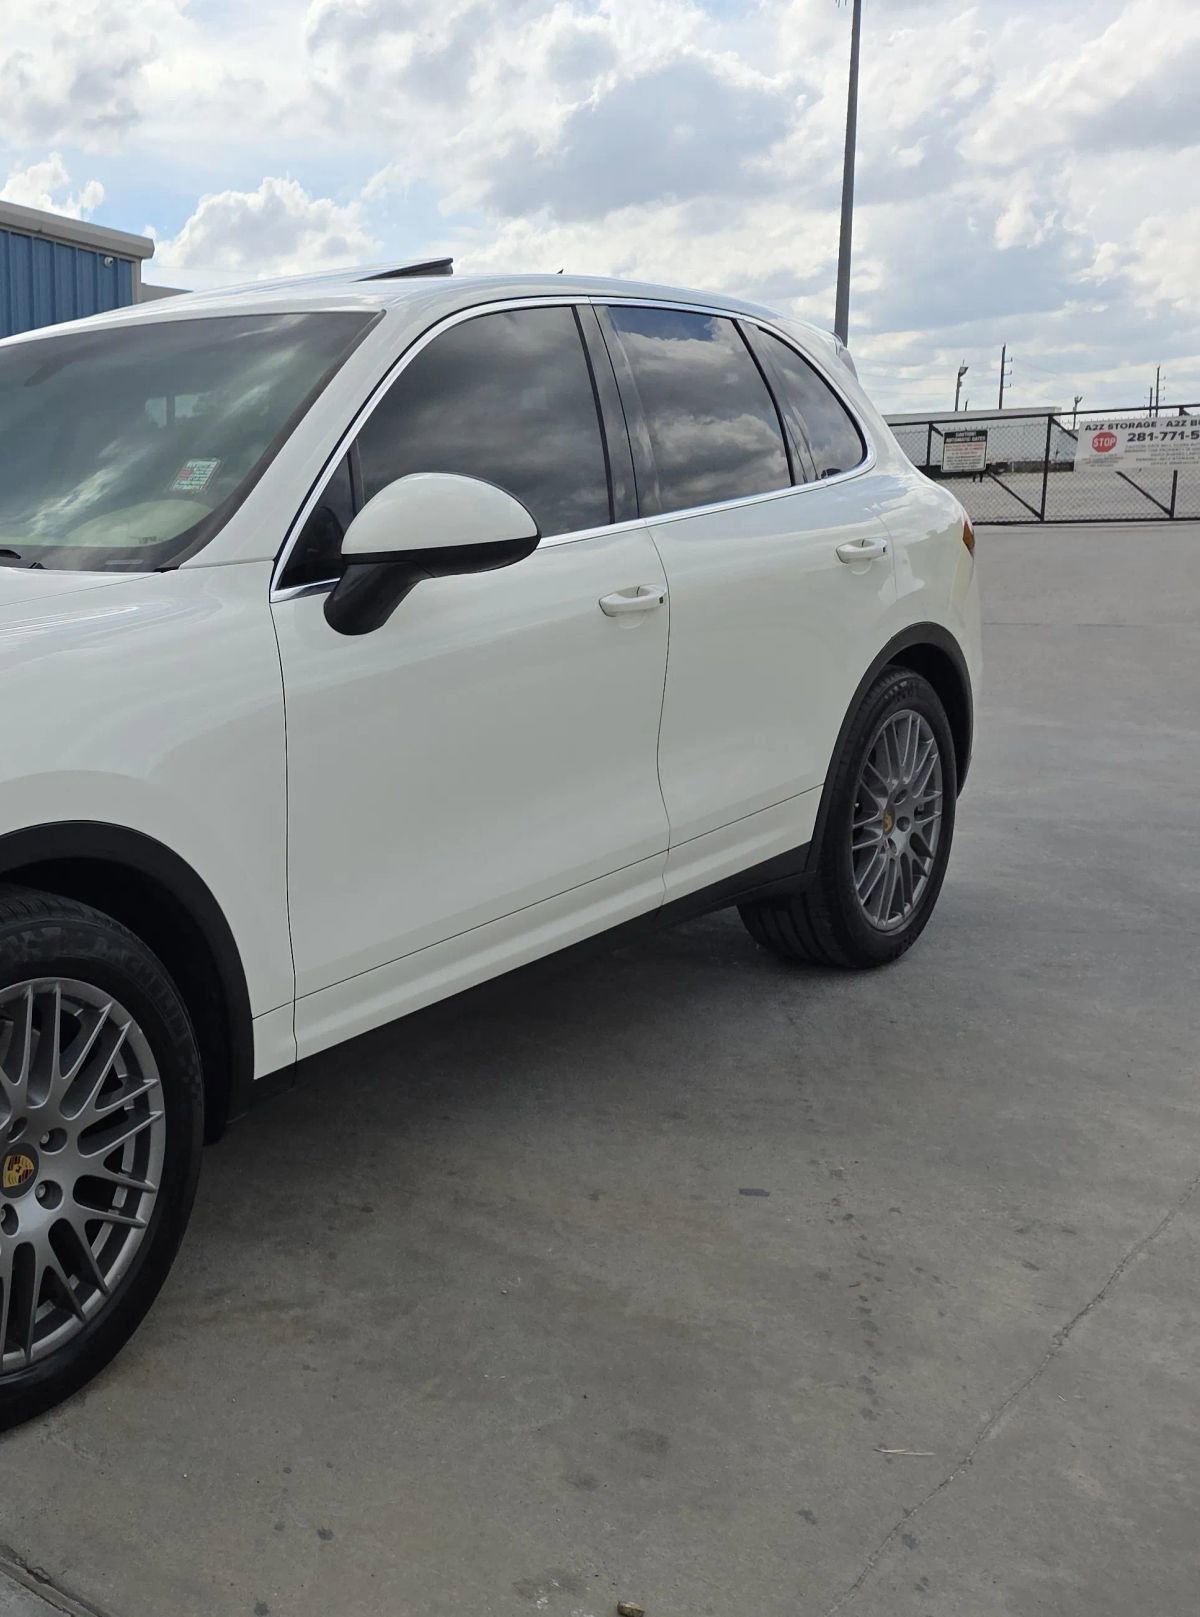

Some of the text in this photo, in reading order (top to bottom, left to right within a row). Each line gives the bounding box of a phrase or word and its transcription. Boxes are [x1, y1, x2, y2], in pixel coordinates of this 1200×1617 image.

[1108, 421, 1157, 430] STORAGE
[1127, 430, 1200, 442] 281-771-5
[1093, 437, 1116, 448] STOP
